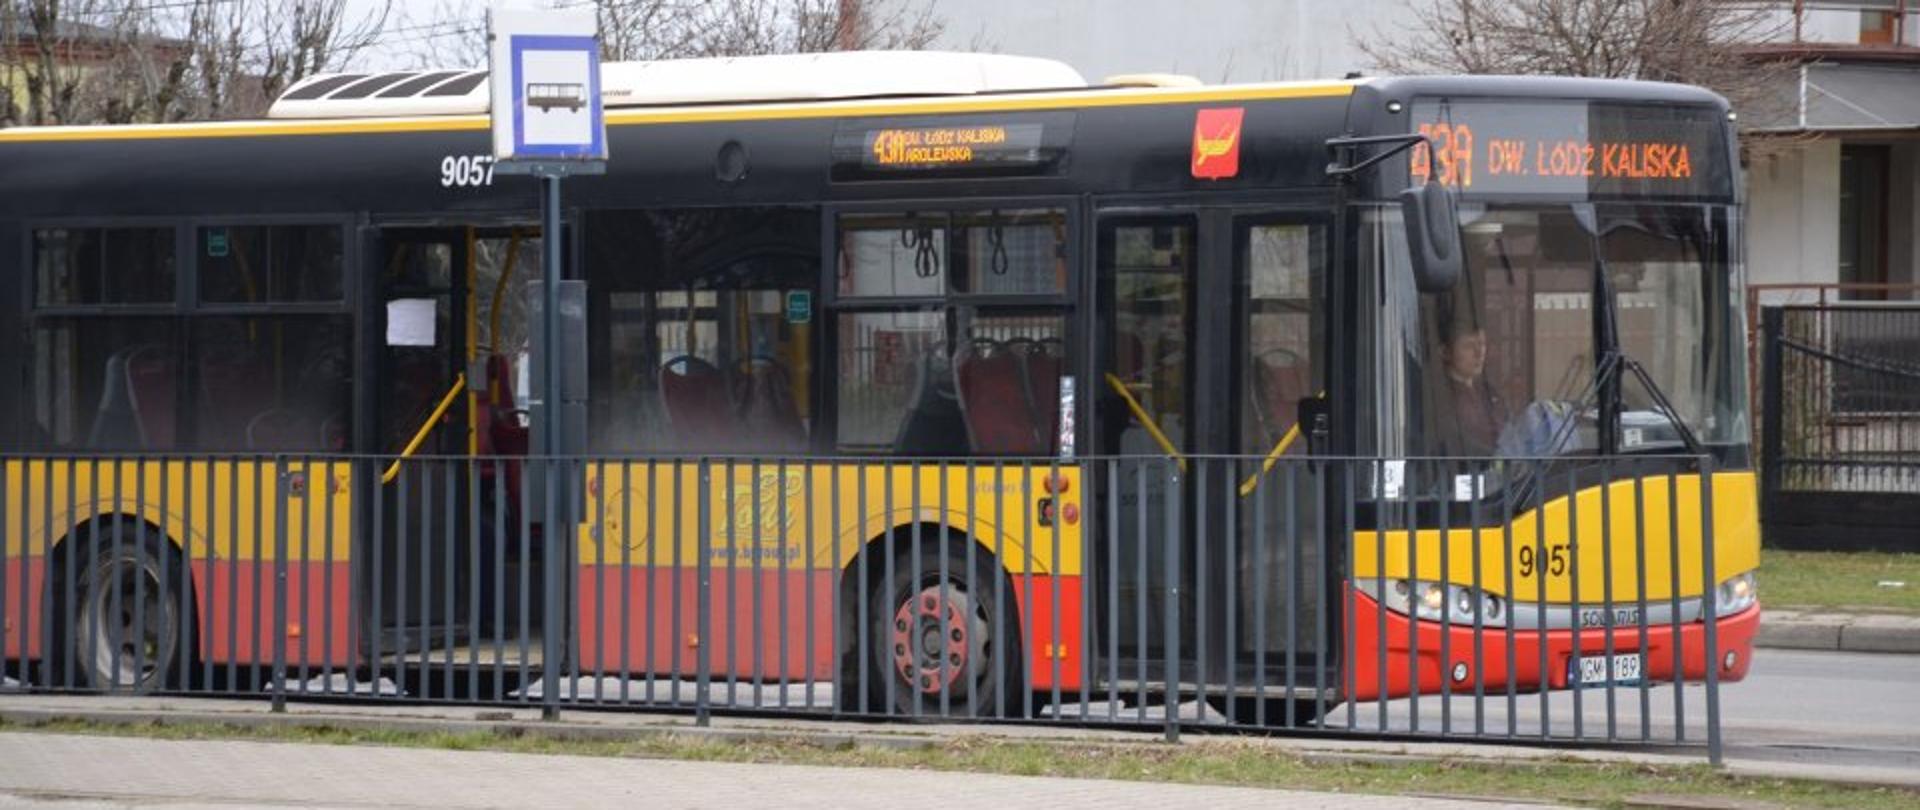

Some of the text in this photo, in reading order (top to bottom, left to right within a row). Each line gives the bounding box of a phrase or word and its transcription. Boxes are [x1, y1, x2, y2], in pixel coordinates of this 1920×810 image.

[874, 129, 905, 164] 43A
[1411, 123, 1473, 187] 43A
[1488, 139, 1528, 174] DW.
[1602, 143, 1691, 178] KALISKA
[441, 155, 496, 187] 9057
